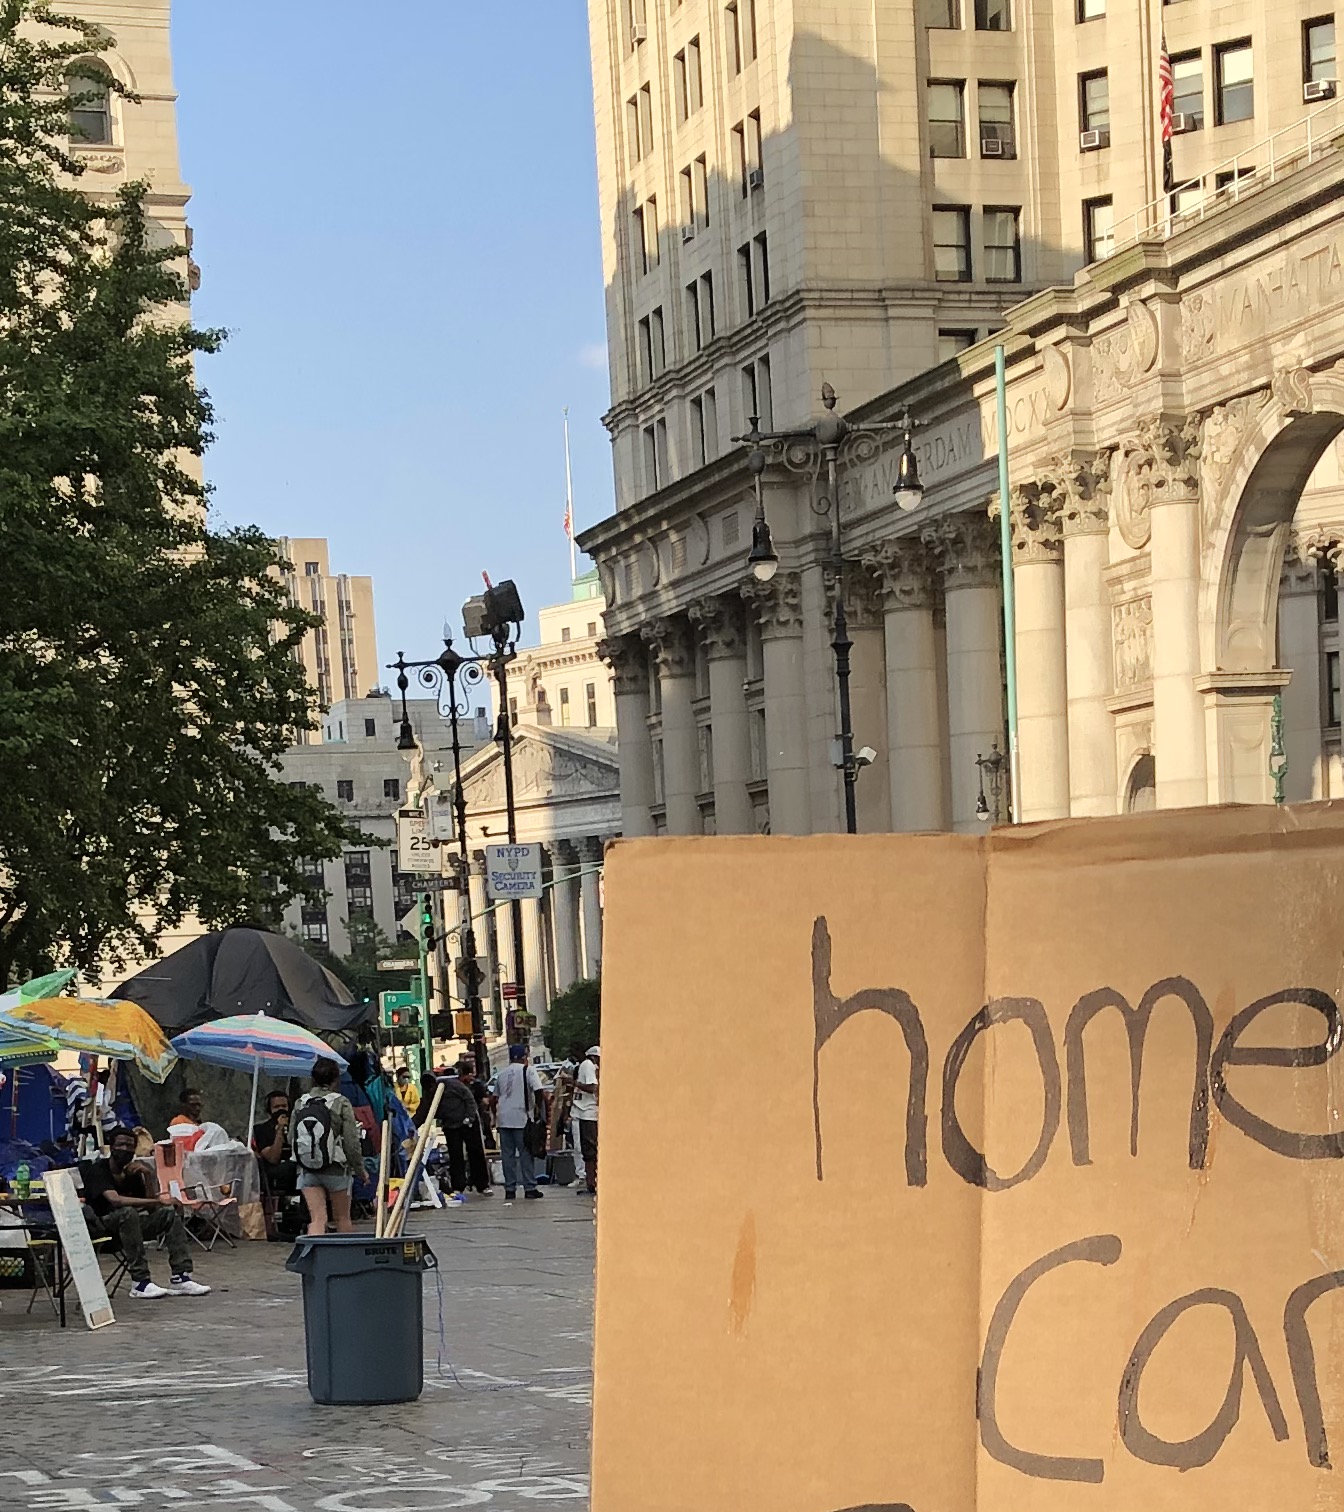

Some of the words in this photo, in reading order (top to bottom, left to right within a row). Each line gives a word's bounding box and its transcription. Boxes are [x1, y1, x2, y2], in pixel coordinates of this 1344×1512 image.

[870, 422, 972, 500] AMERDAM
[410, 837, 431, 850] 25
[496, 847, 530, 858] NYPD
[411, 878, 454, 889] CHAMBERS
